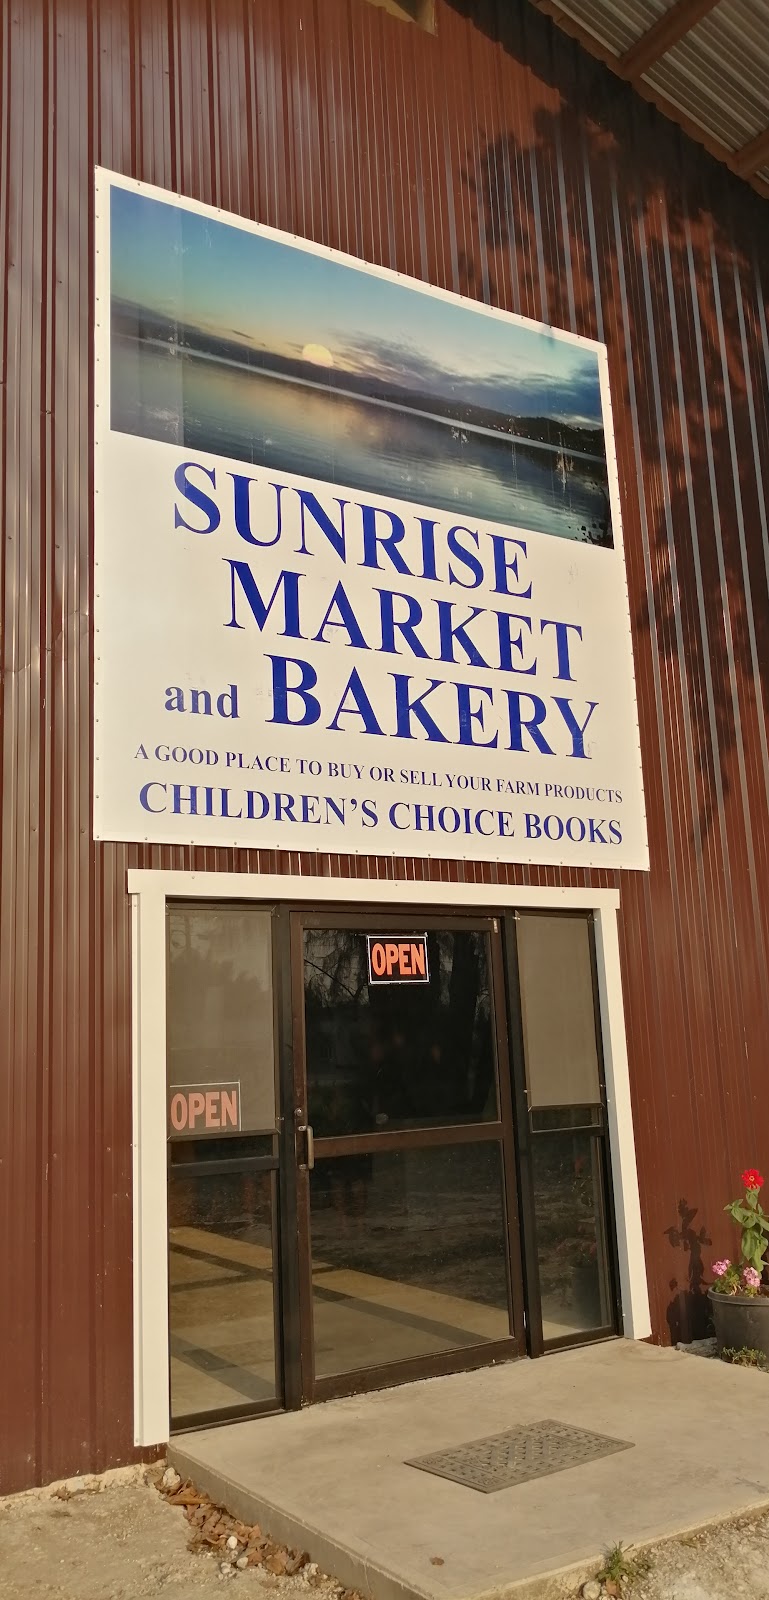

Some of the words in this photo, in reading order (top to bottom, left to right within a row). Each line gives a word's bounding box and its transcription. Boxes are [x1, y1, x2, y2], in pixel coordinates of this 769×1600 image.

[173, 461, 533, 600] SUNRISE
[222, 557, 583, 682] MARKET
[164, 684, 239, 719] and
[264, 653, 599, 760] BAKERY
[134, 743, 149, 760] A
[154, 744, 219, 766] GOOD
[225, 751, 291, 773] PLACE
[296, 758, 322, 776] TO
[328, 762, 365, 780] BUY
[369, 766, 396, 783] OR
[400, 768, 442, 787] SELL
[445, 773, 493, 792] YOUR
[496, 778, 540, 796] FARM
[544, 783, 623, 803] PRODUCTS
[139, 781, 379, 828] CHILDREN'S
[388, 802, 515, 838] CHOICE
[523, 812, 623, 845] BOOKS
[371, 942, 426, 976] OPEN
[170, 1090, 238, 1131] OPEN
